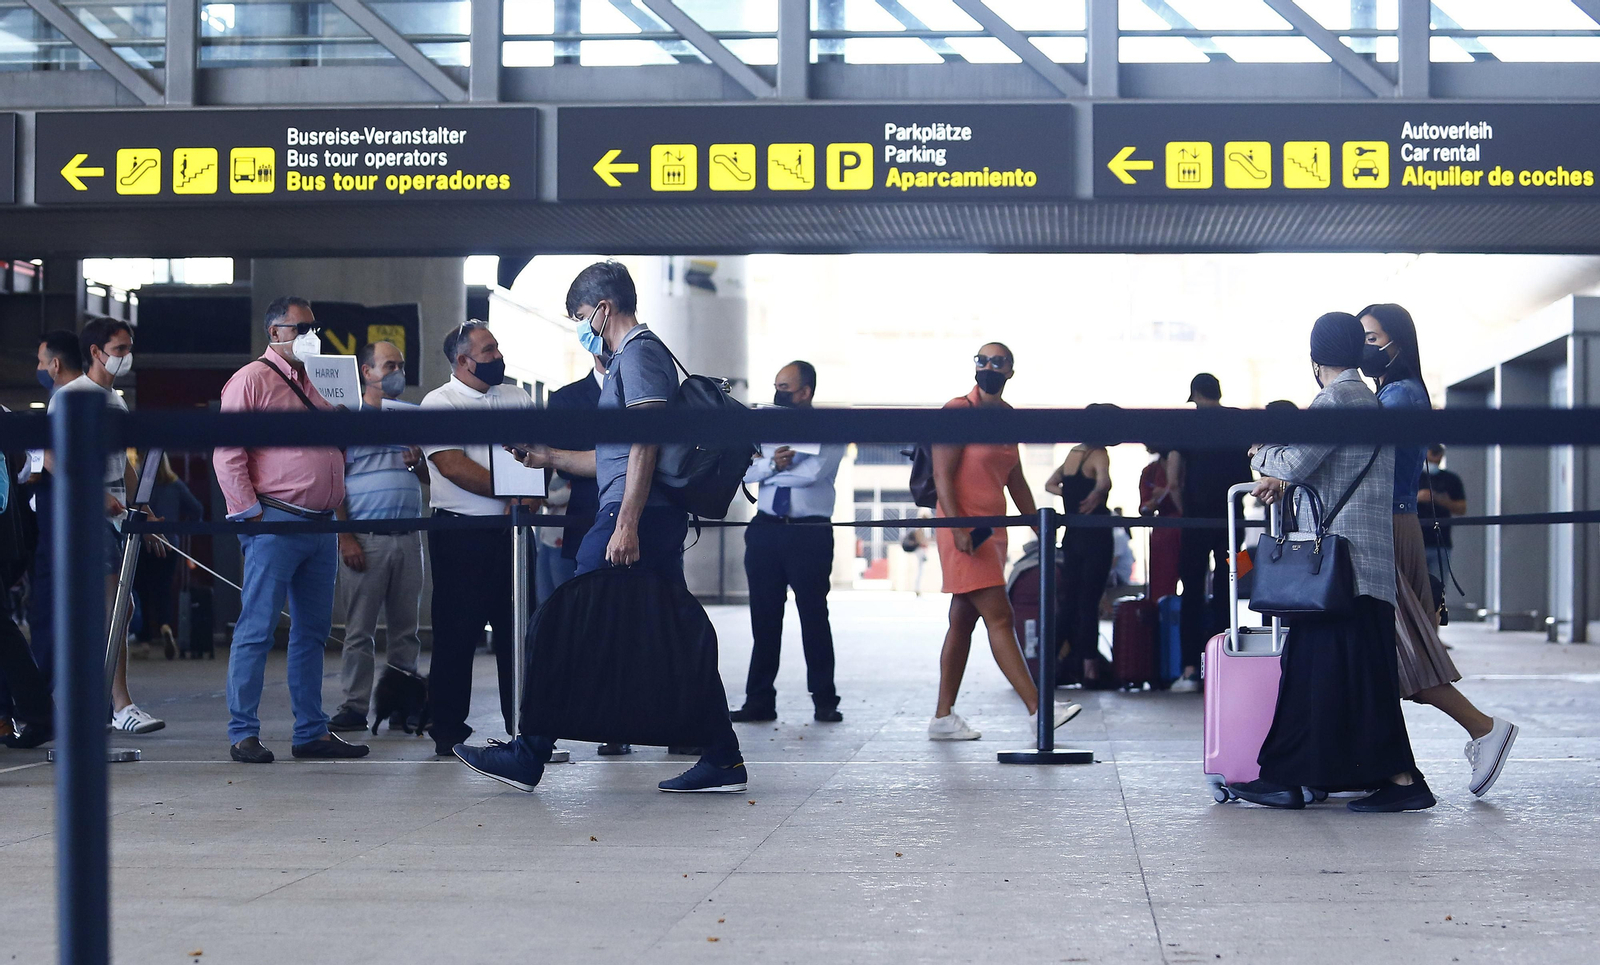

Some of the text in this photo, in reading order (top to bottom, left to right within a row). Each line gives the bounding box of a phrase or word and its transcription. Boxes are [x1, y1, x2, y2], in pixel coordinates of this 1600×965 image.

[286, 127, 467, 146] Busreise-Veranstalter
[884, 122, 973, 143] Parkplätze
[1400, 121, 1493, 140] Autoverleih
[286, 150, 448, 169] Bus tour operators
[884, 145, 947, 165] Parking
[1400, 143, 1481, 162] Car rental
[839, 151, 861, 182] P
[286, 171, 511, 194] Bus tour operadores
[885, 167, 1038, 191] Aparcamiento
[1401, 165, 1595, 190] Alquiler de coches
[315, 368, 340, 379] HARRY
